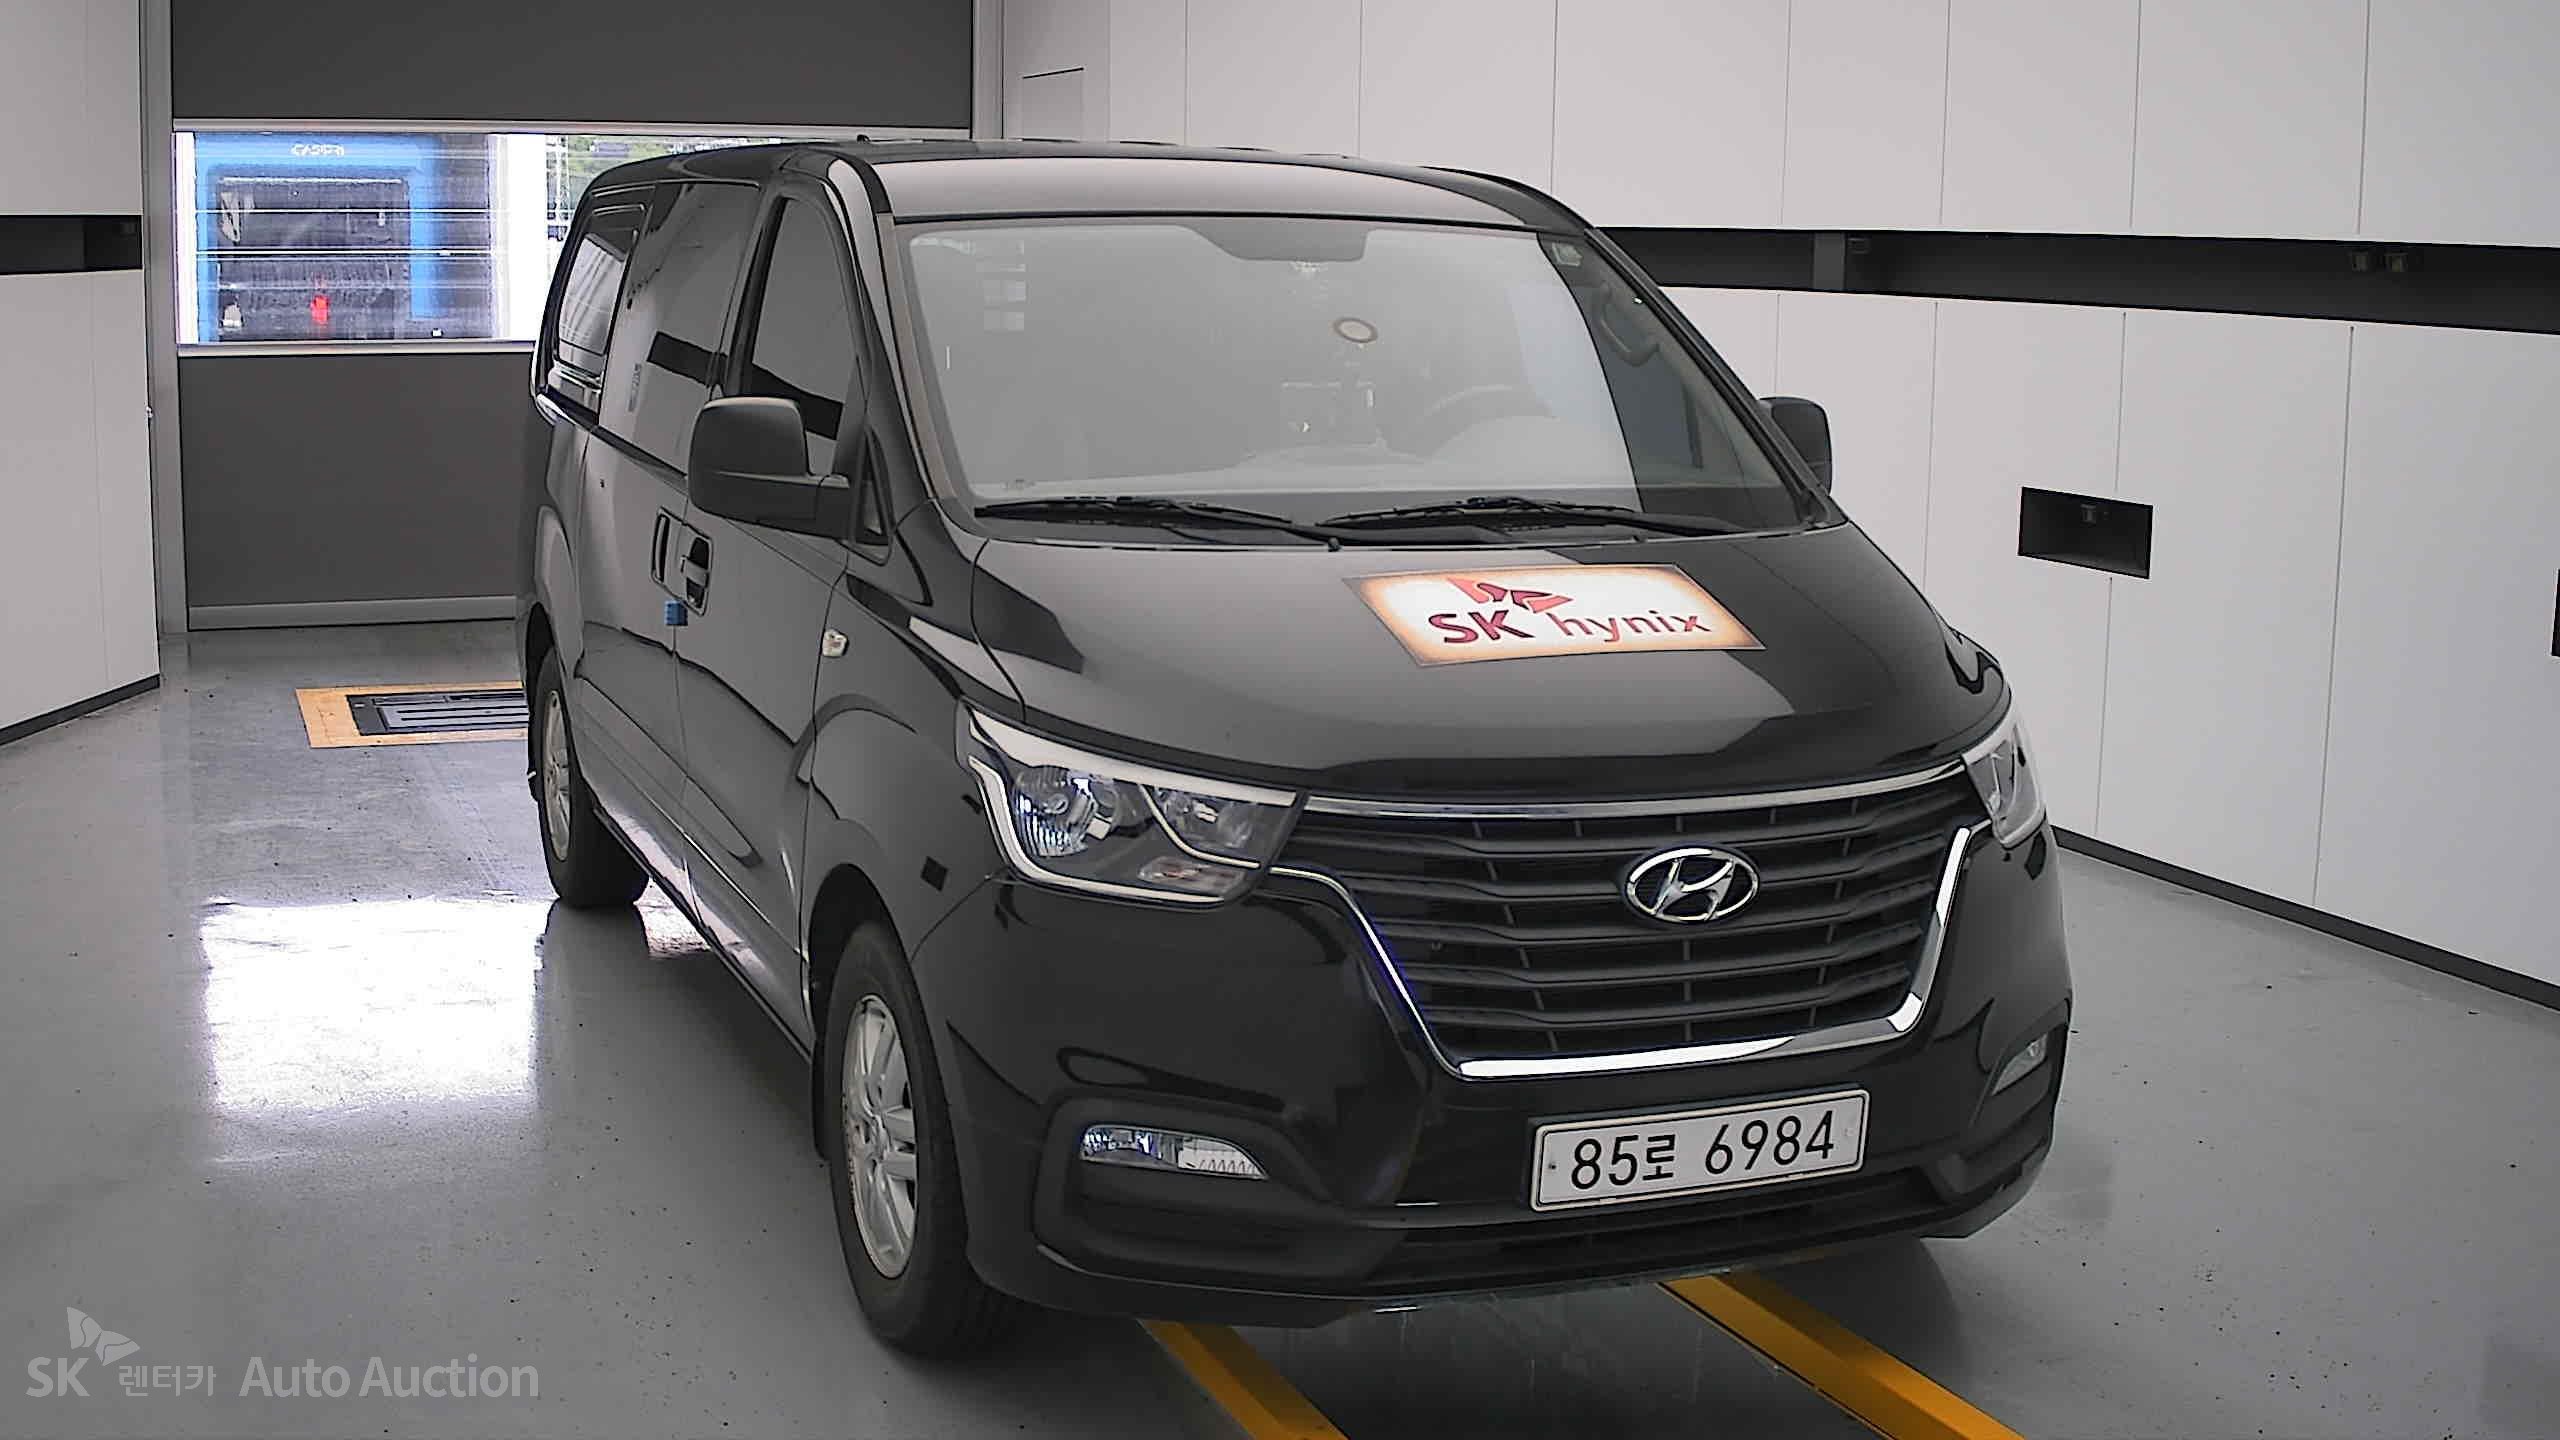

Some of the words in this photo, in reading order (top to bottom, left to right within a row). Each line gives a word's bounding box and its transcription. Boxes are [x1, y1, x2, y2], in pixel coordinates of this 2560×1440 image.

[1428, 611, 1534, 643] SK
[1547, 609, 1712, 643] hynix
[1571, 1133, 1675, 1190] 85로
[1705, 1110, 1834, 1175] 6984
